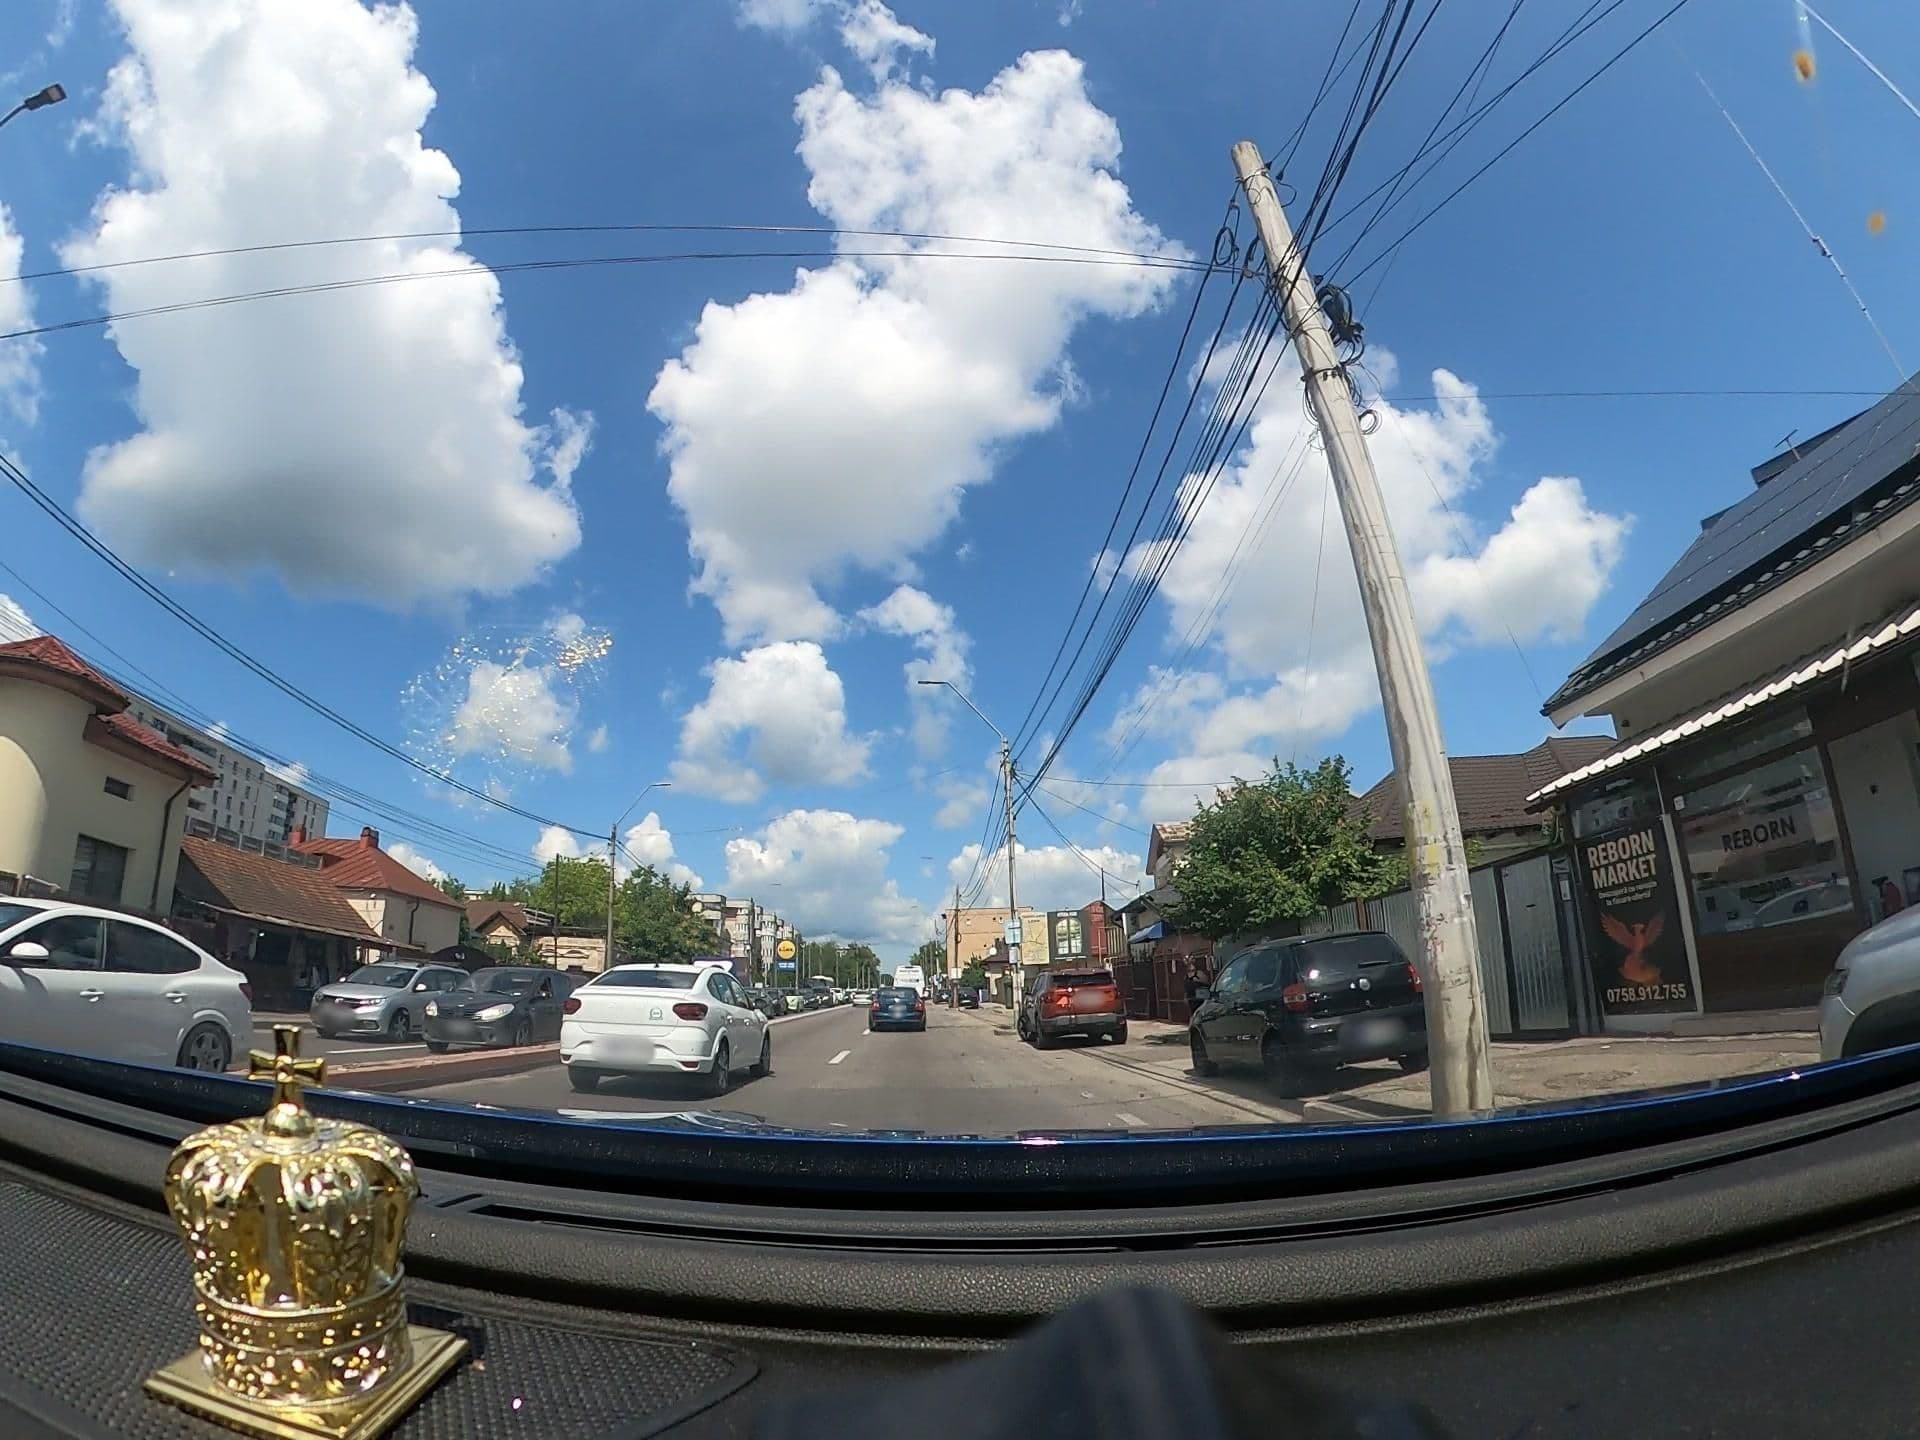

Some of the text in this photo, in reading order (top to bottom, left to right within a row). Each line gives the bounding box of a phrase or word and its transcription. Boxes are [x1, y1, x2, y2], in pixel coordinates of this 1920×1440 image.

[1587, 828, 1655, 868] REBORN
[1721, 815, 1797, 852] REBORN
[1592, 853, 1657, 890] MARKET
[1606, 983, 1687, 1003] 0758.912.755
